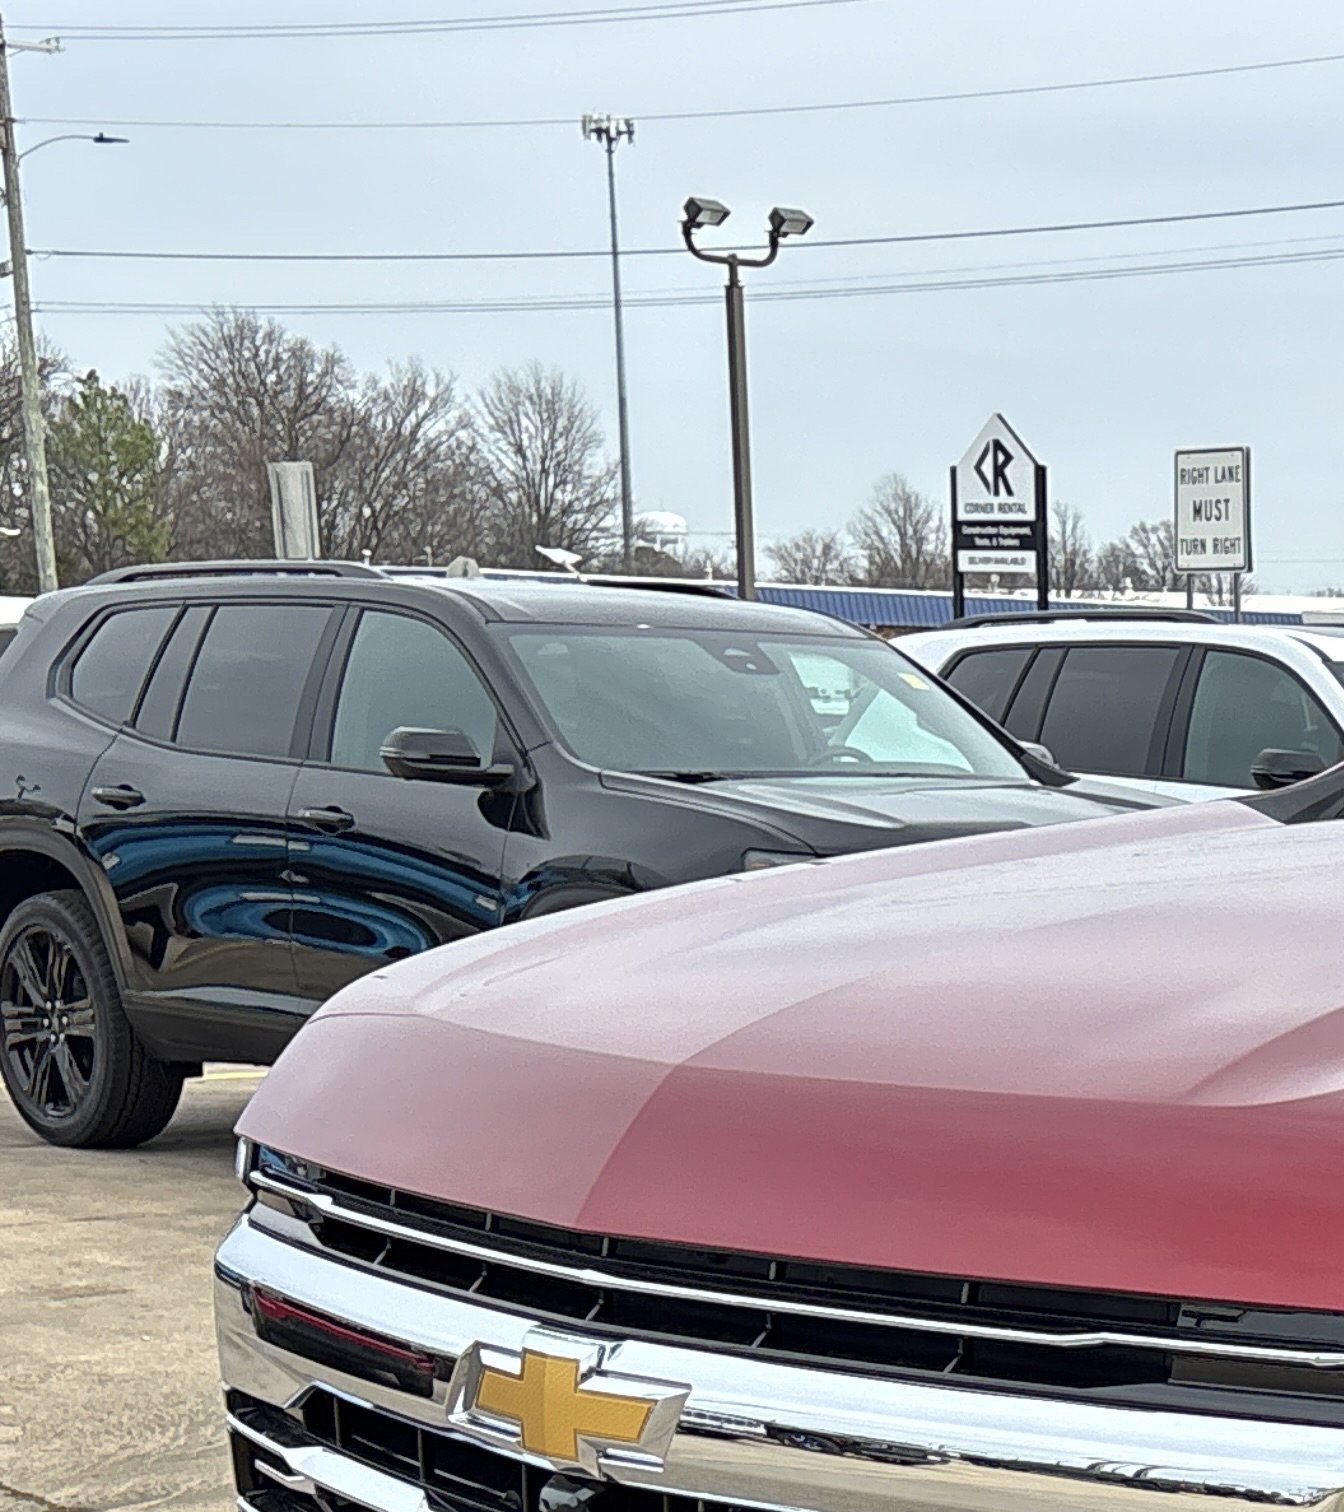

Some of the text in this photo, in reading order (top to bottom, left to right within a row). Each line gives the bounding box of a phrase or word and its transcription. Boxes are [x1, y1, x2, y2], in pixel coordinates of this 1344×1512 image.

[1180, 465, 1240, 485] RIGHT LANE
[964, 502, 1027, 514] CORNER RENTAL
[1192, 498, 1230, 522] MUST
[1180, 536, 1241, 556] TURN RIGHT
